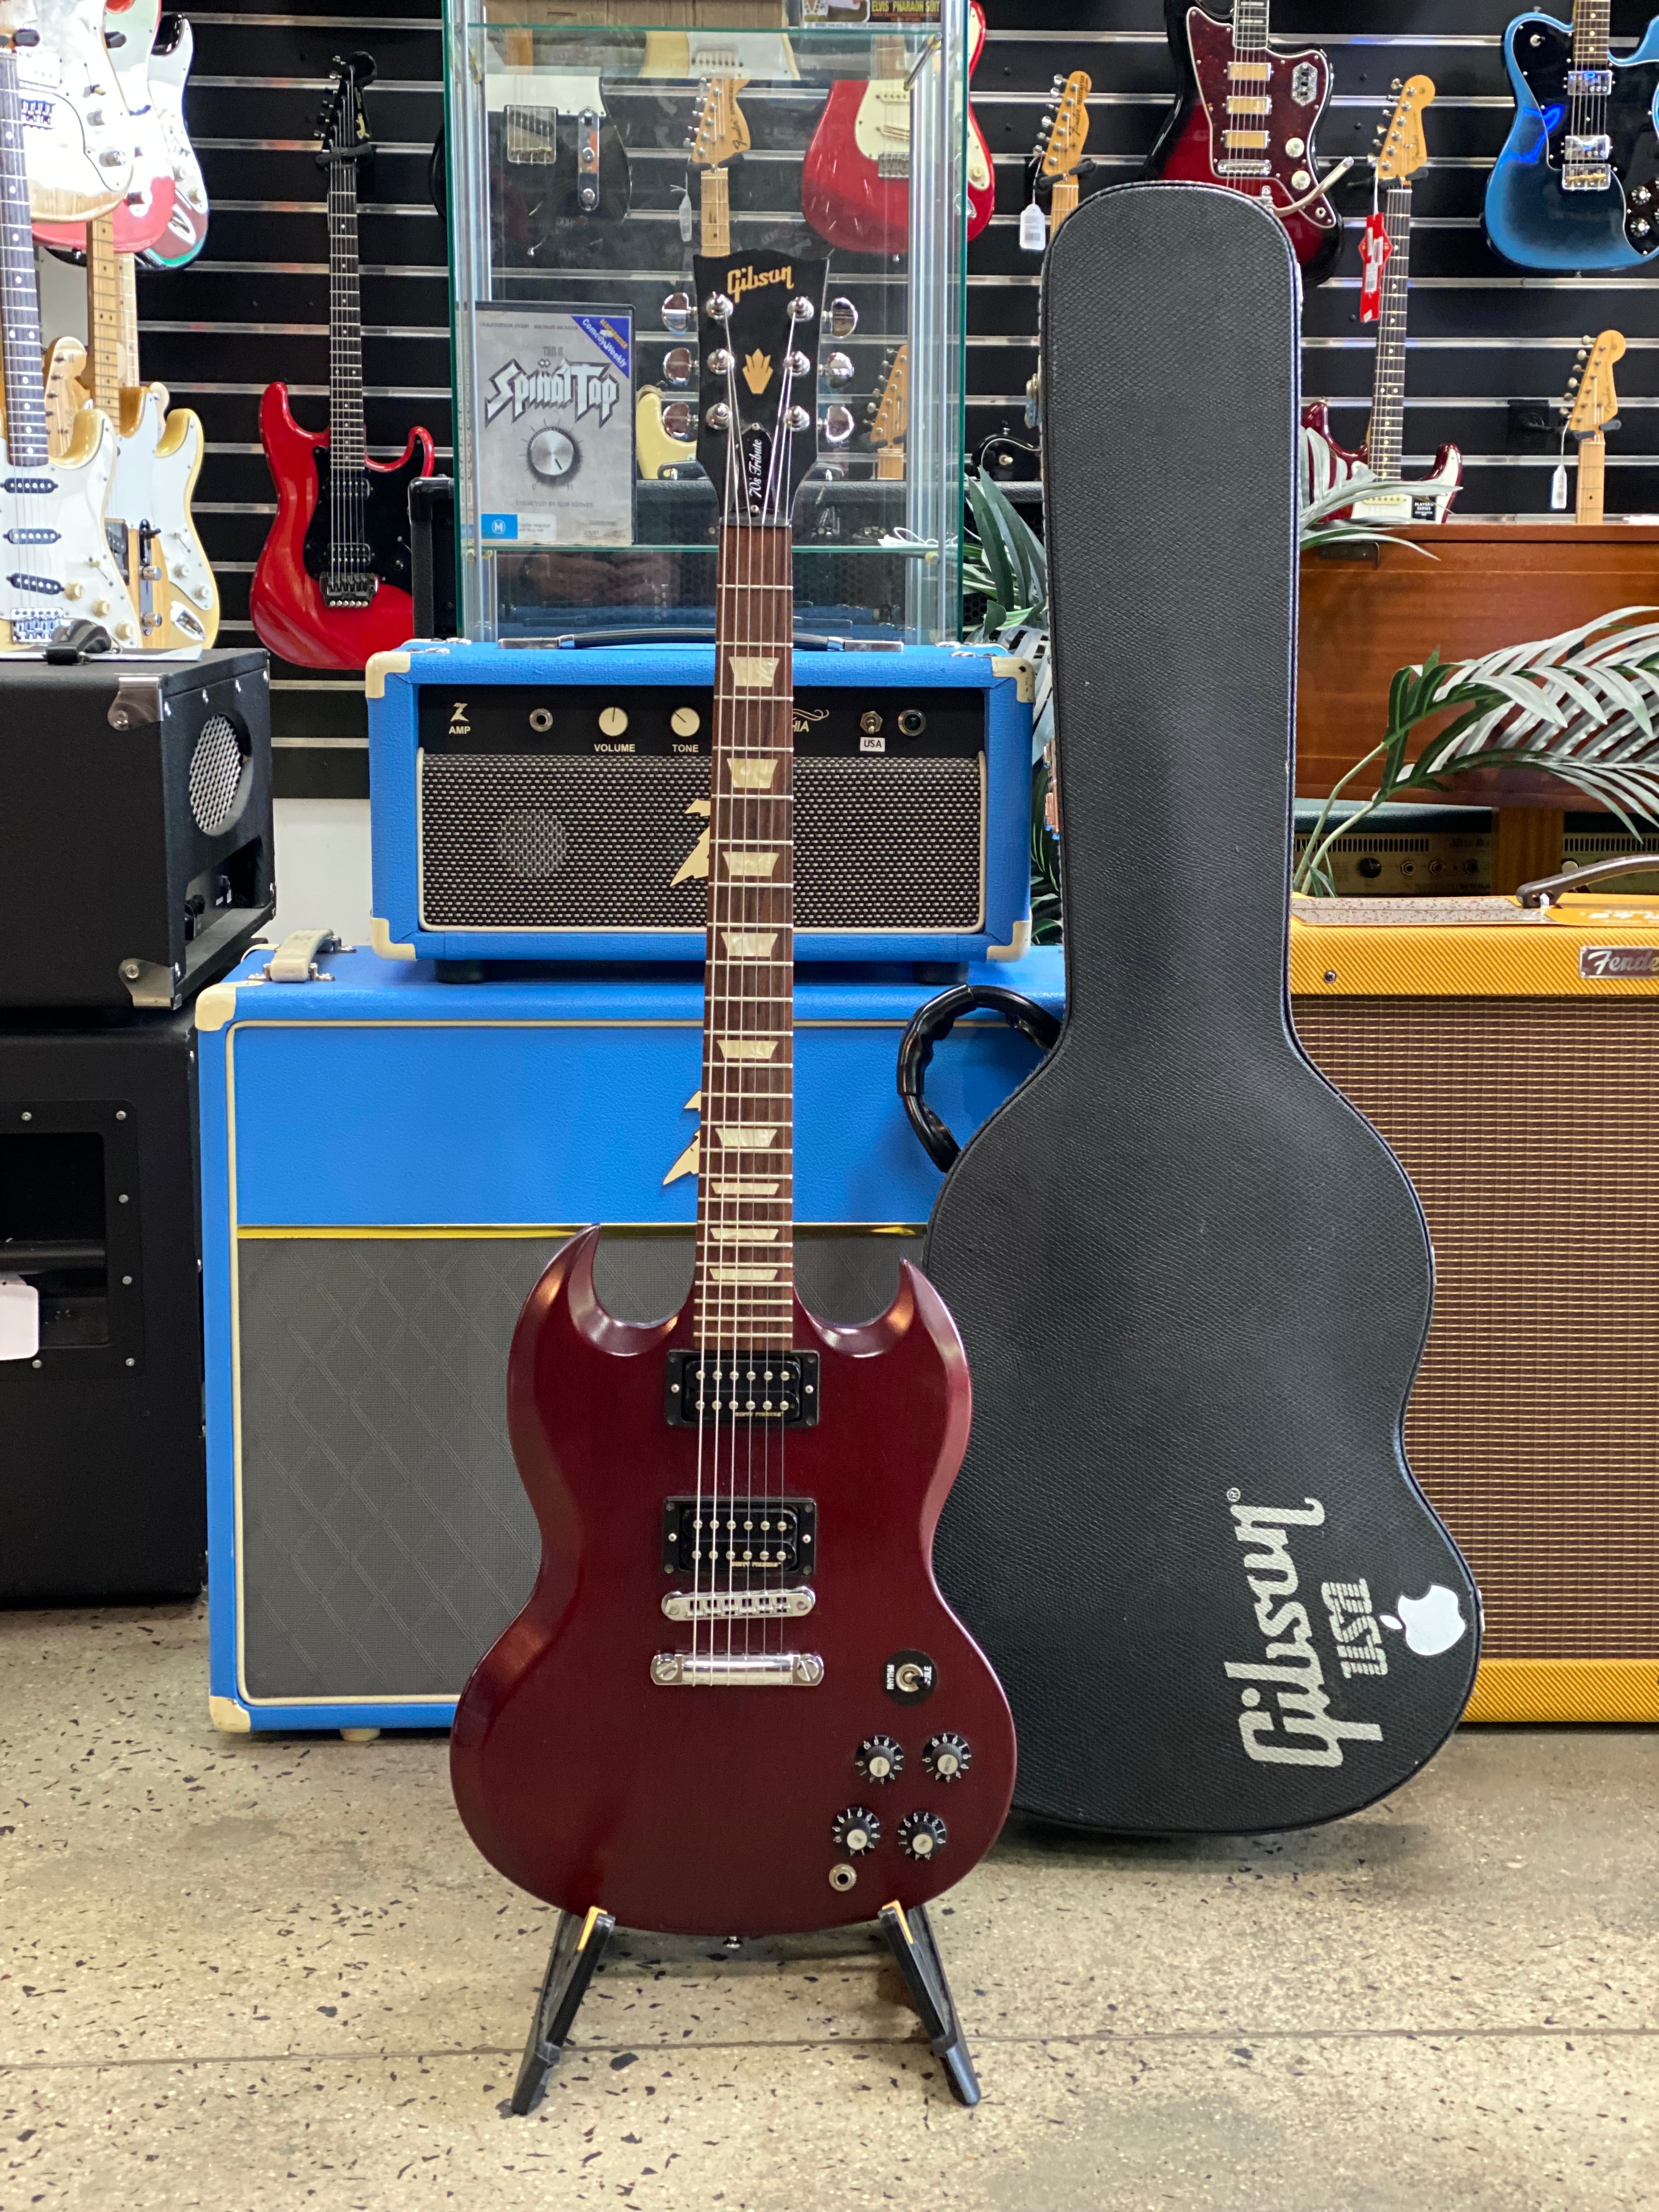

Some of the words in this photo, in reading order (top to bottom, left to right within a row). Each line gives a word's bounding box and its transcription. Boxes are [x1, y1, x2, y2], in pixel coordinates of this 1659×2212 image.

[871, 1, 889, 12] ELVIS
[727, 266, 794, 304] Gibson
[582, 318, 606, 347] Comedy
[606, 341, 627, 368] Weekly
[543, 346, 556, 357] THIS
[558, 346, 563, 357] IS
[749, 439, 763, 476] Tribute
[448, 726, 471, 734] AMP
[594, 743, 636, 753] VOLUME
[672, 744, 699, 753] TONE
[864, 739, 882, 748] USA
[1588, 950, 1659, 975] Fende
[1321, 1577, 1389, 1679] USA
